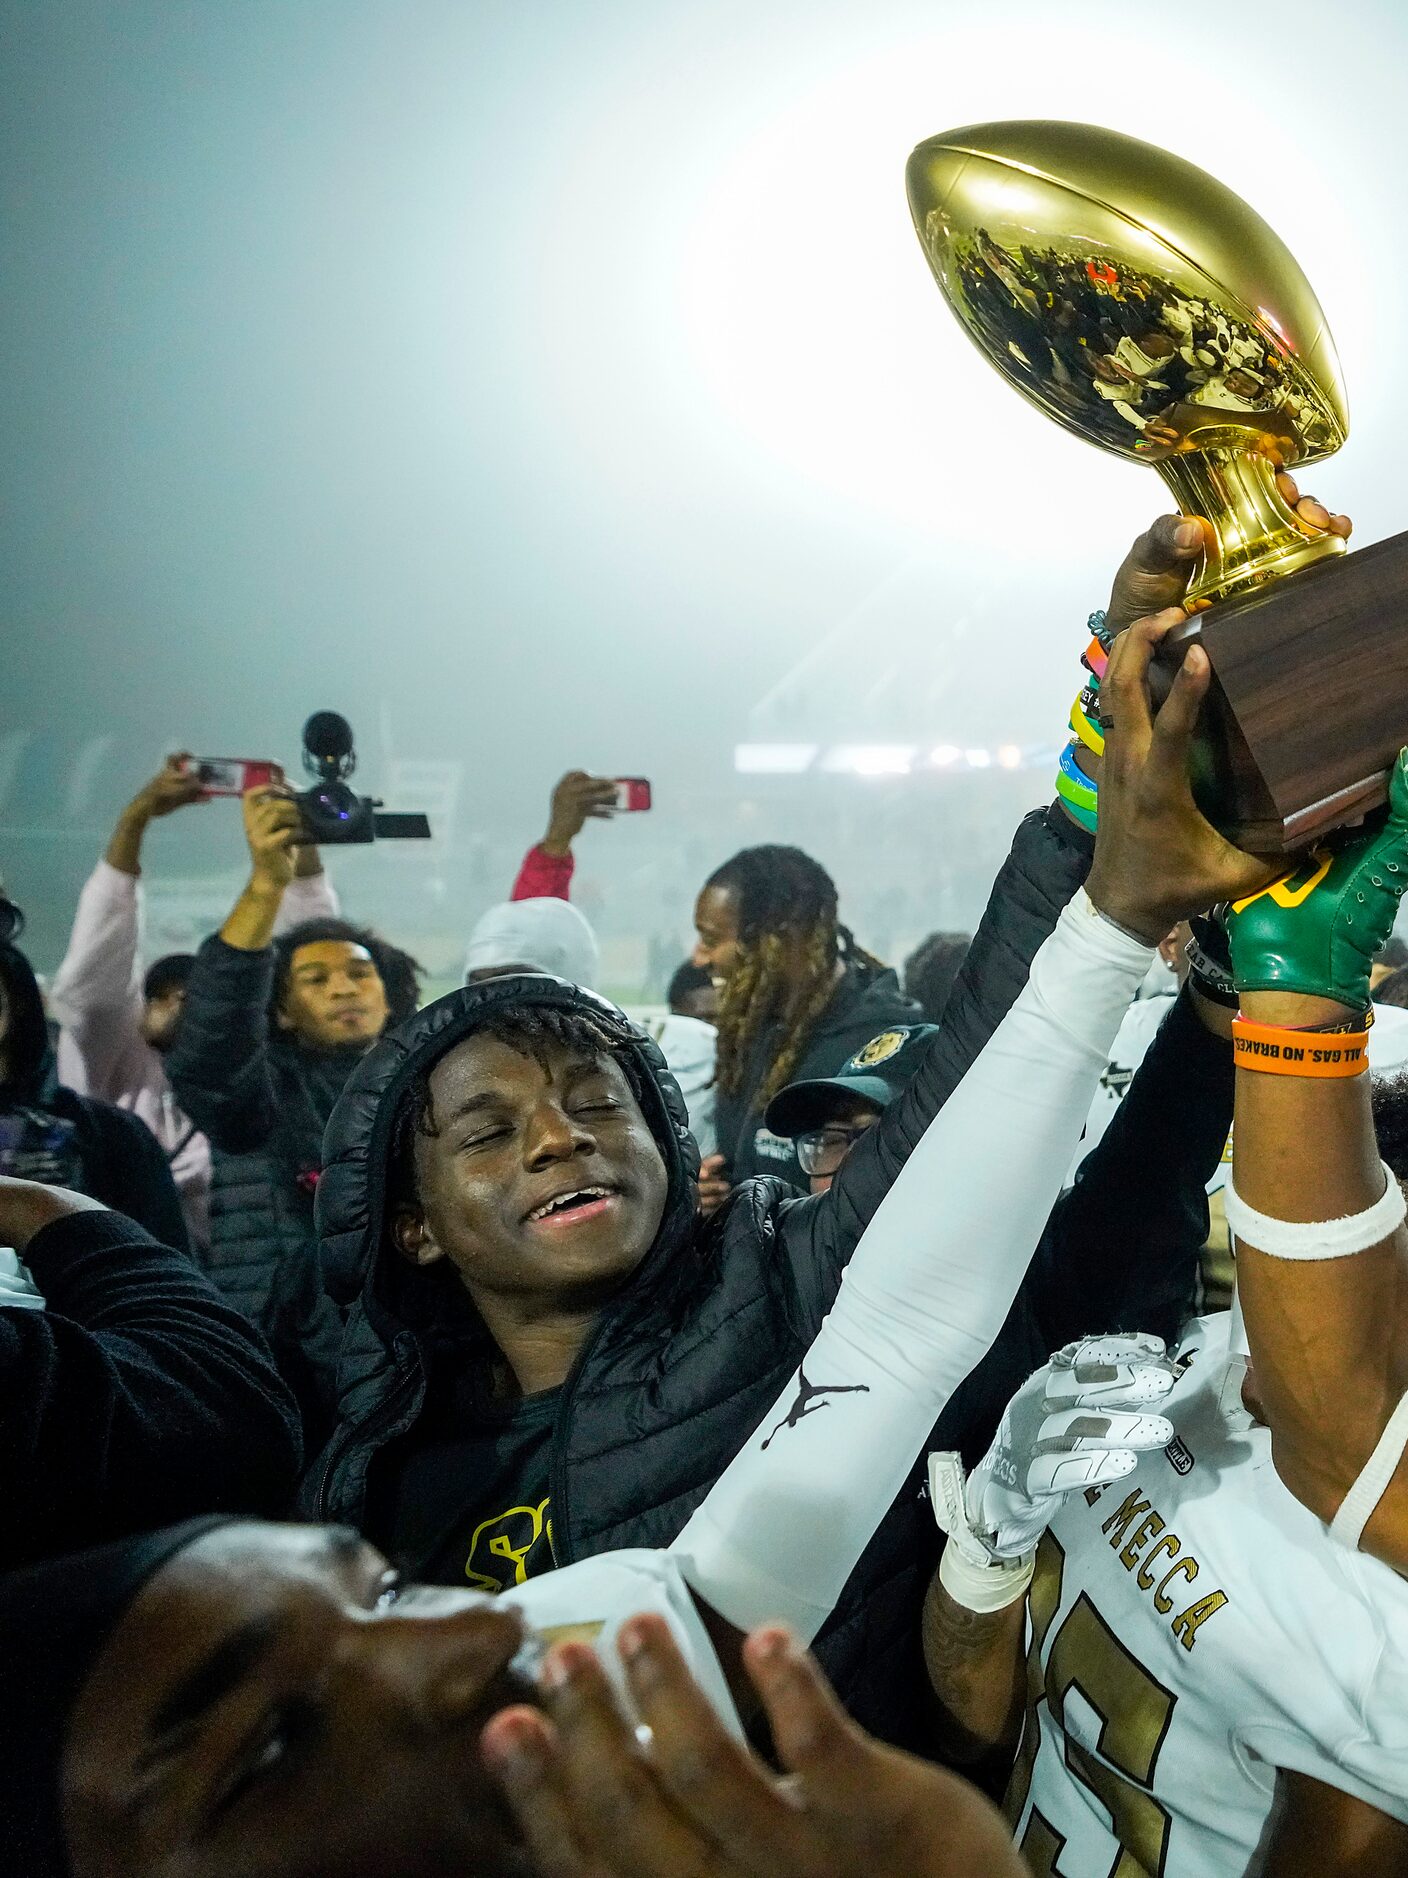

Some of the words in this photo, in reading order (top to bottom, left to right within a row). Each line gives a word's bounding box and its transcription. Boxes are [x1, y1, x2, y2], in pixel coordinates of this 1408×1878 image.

[1283, 1047, 1304, 1061] NO
[1308, 1049, 1341, 1063] GAS.
[1345, 1047, 1362, 1062] ALL
[1101, 1487, 1230, 1653] MECCA
